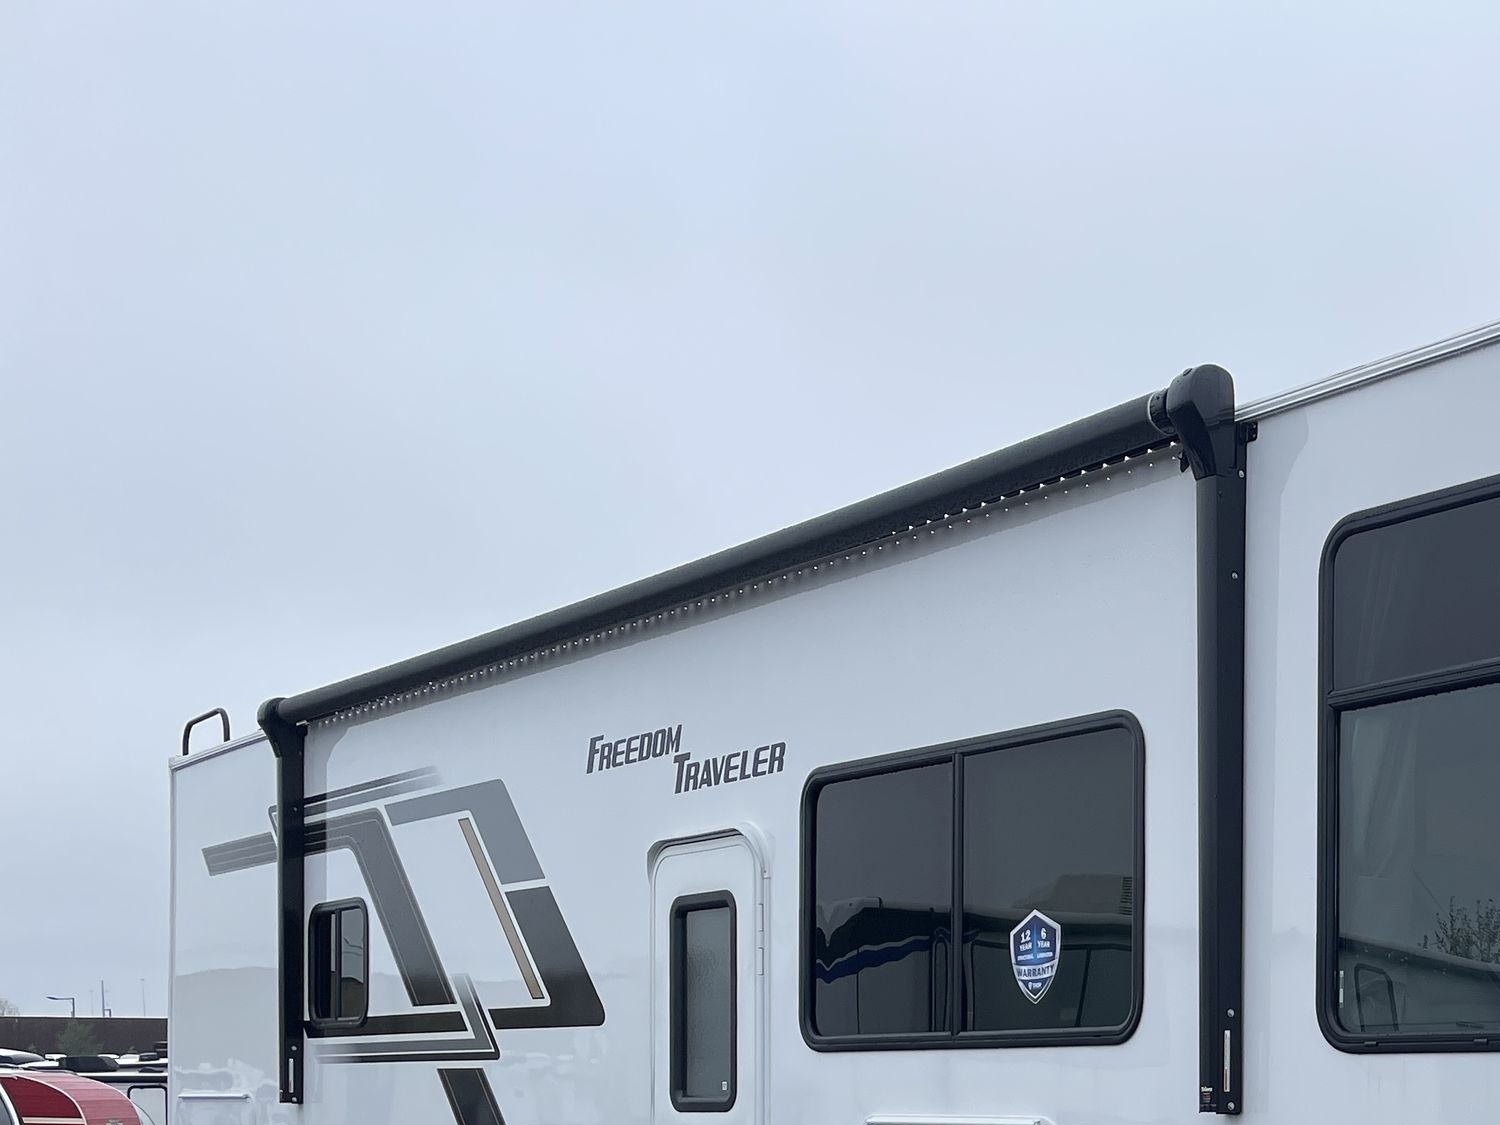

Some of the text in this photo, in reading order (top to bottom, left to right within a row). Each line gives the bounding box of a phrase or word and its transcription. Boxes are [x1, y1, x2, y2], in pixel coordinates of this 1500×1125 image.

[586, 724, 682, 774] FREEDOM
[673, 741, 786, 794] TRAVELER
[1021, 929, 1031, 943] 12
[1041, 928, 1047, 939] 6
[1019, 942, 1032, 952] YEAR
[1037, 940, 1050, 948] YEAR
[1017, 965, 1054, 977] WARRANTY
